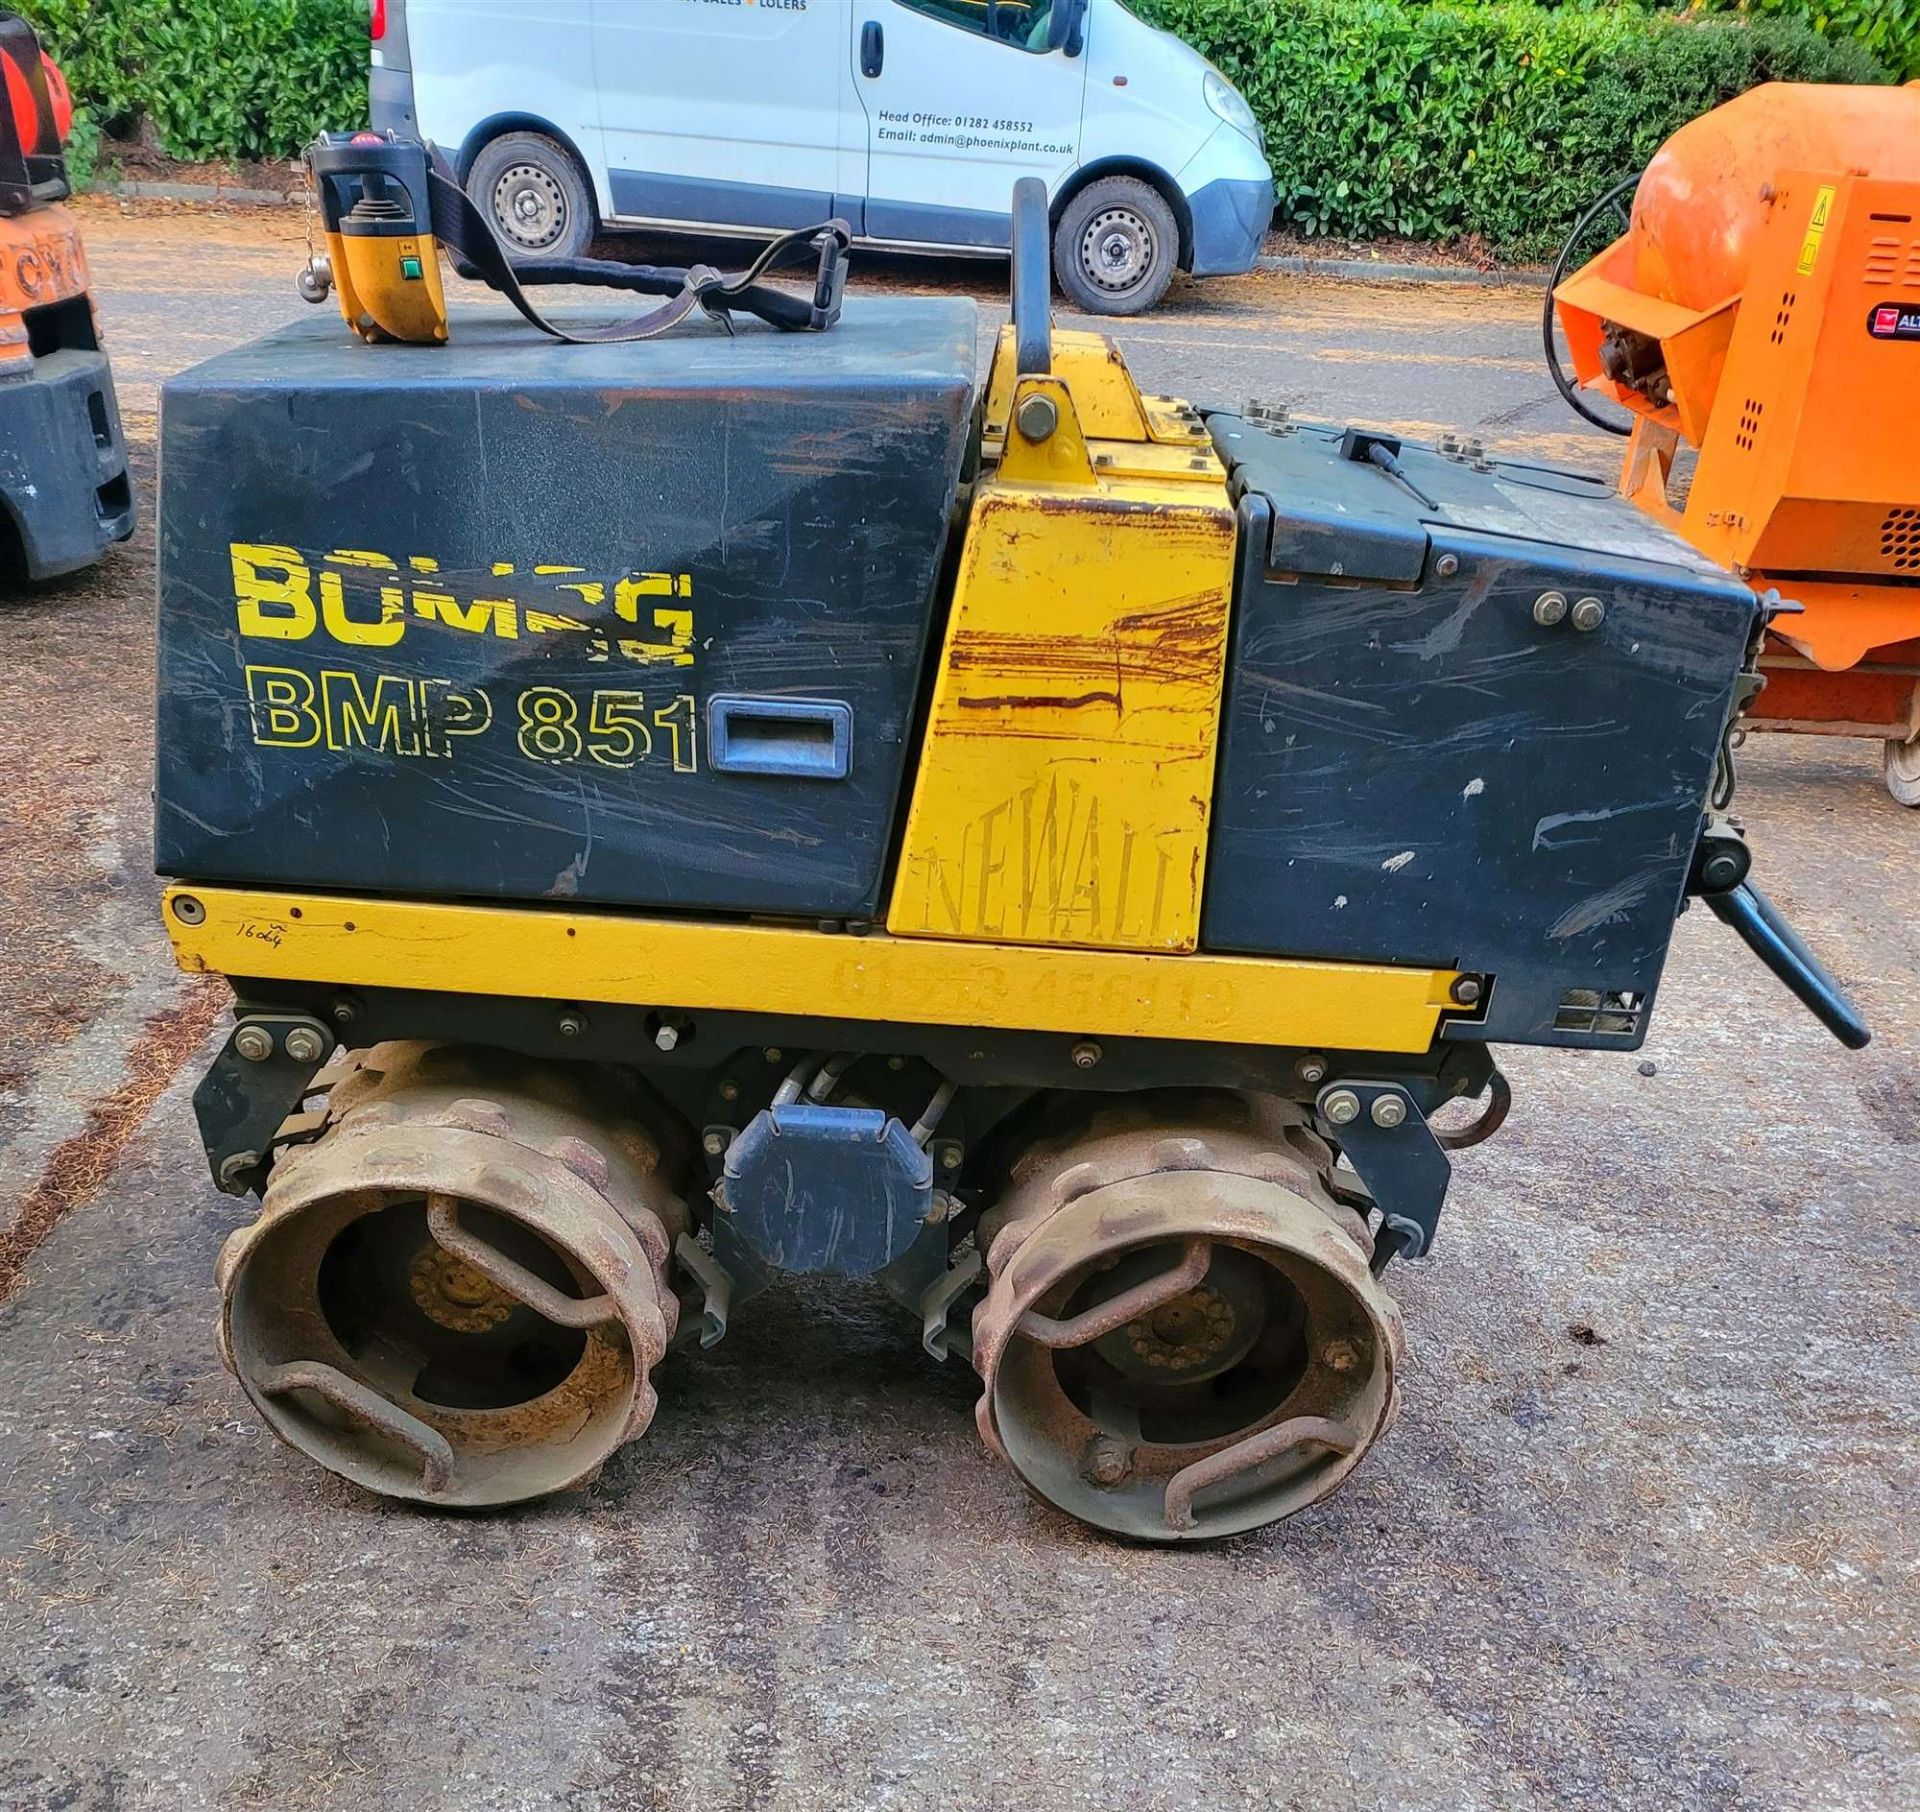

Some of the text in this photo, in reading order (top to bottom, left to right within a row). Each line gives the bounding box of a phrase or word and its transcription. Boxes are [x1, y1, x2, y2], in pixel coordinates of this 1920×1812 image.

[878, 110, 1033, 132] Head Office: 01282 458552
[878, 128, 1074, 155] Email: admin@phoenixplant.co.uk
[245, 665, 698, 773] BMP 851
